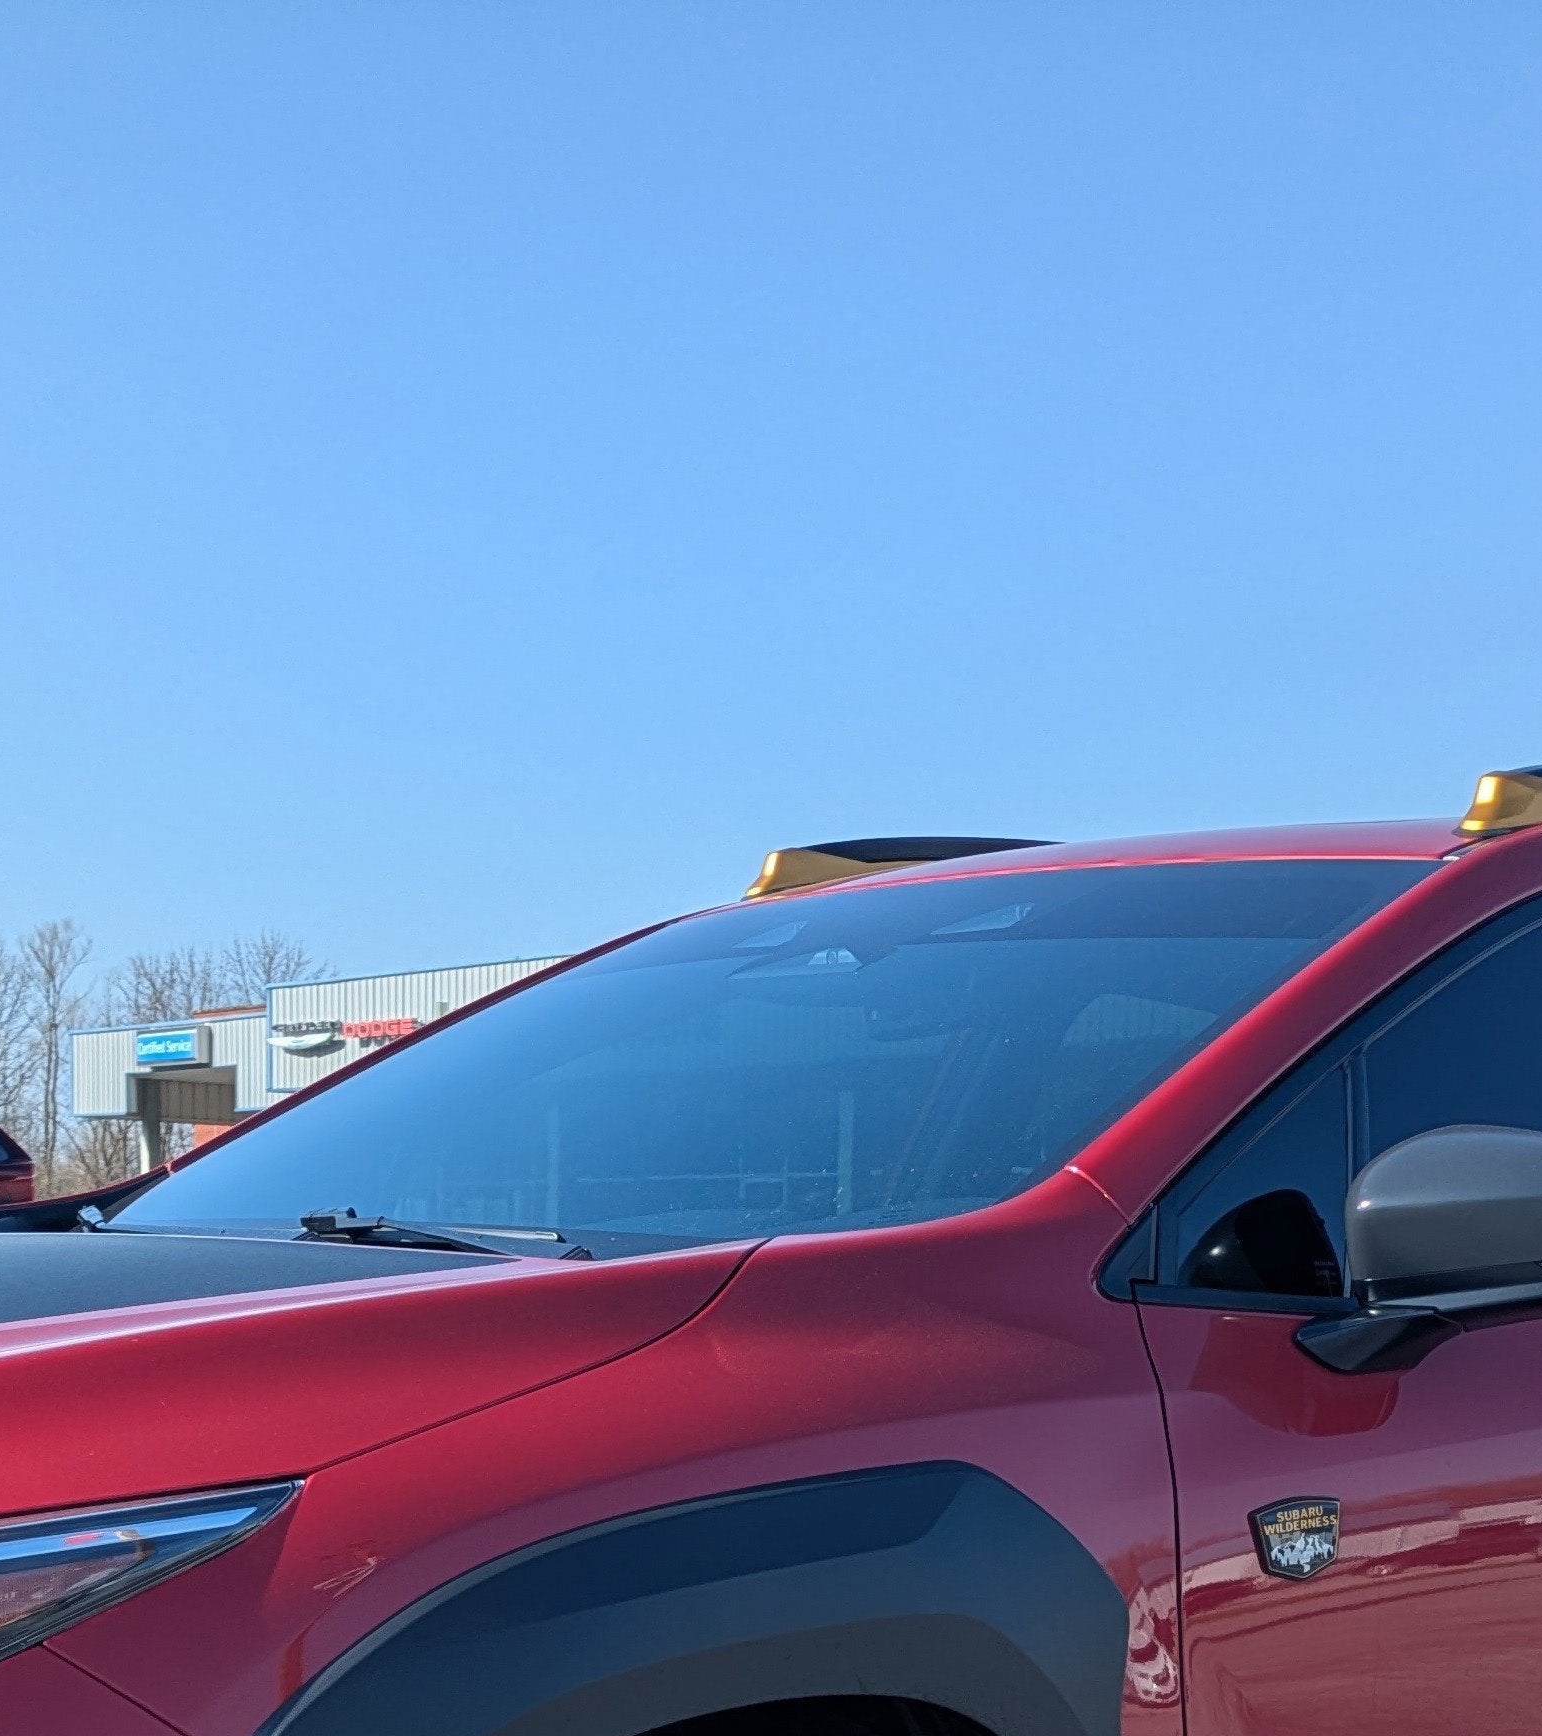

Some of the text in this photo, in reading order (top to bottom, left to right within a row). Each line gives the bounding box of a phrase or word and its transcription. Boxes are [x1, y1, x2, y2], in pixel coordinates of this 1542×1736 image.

[342, 1018, 415, 1038] DODGE
[137, 1039, 192, 1056] Certified Service
[1276, 1505, 1324, 1523] SUBARU
[1263, 1514, 1337, 1536] WILDERNESS
